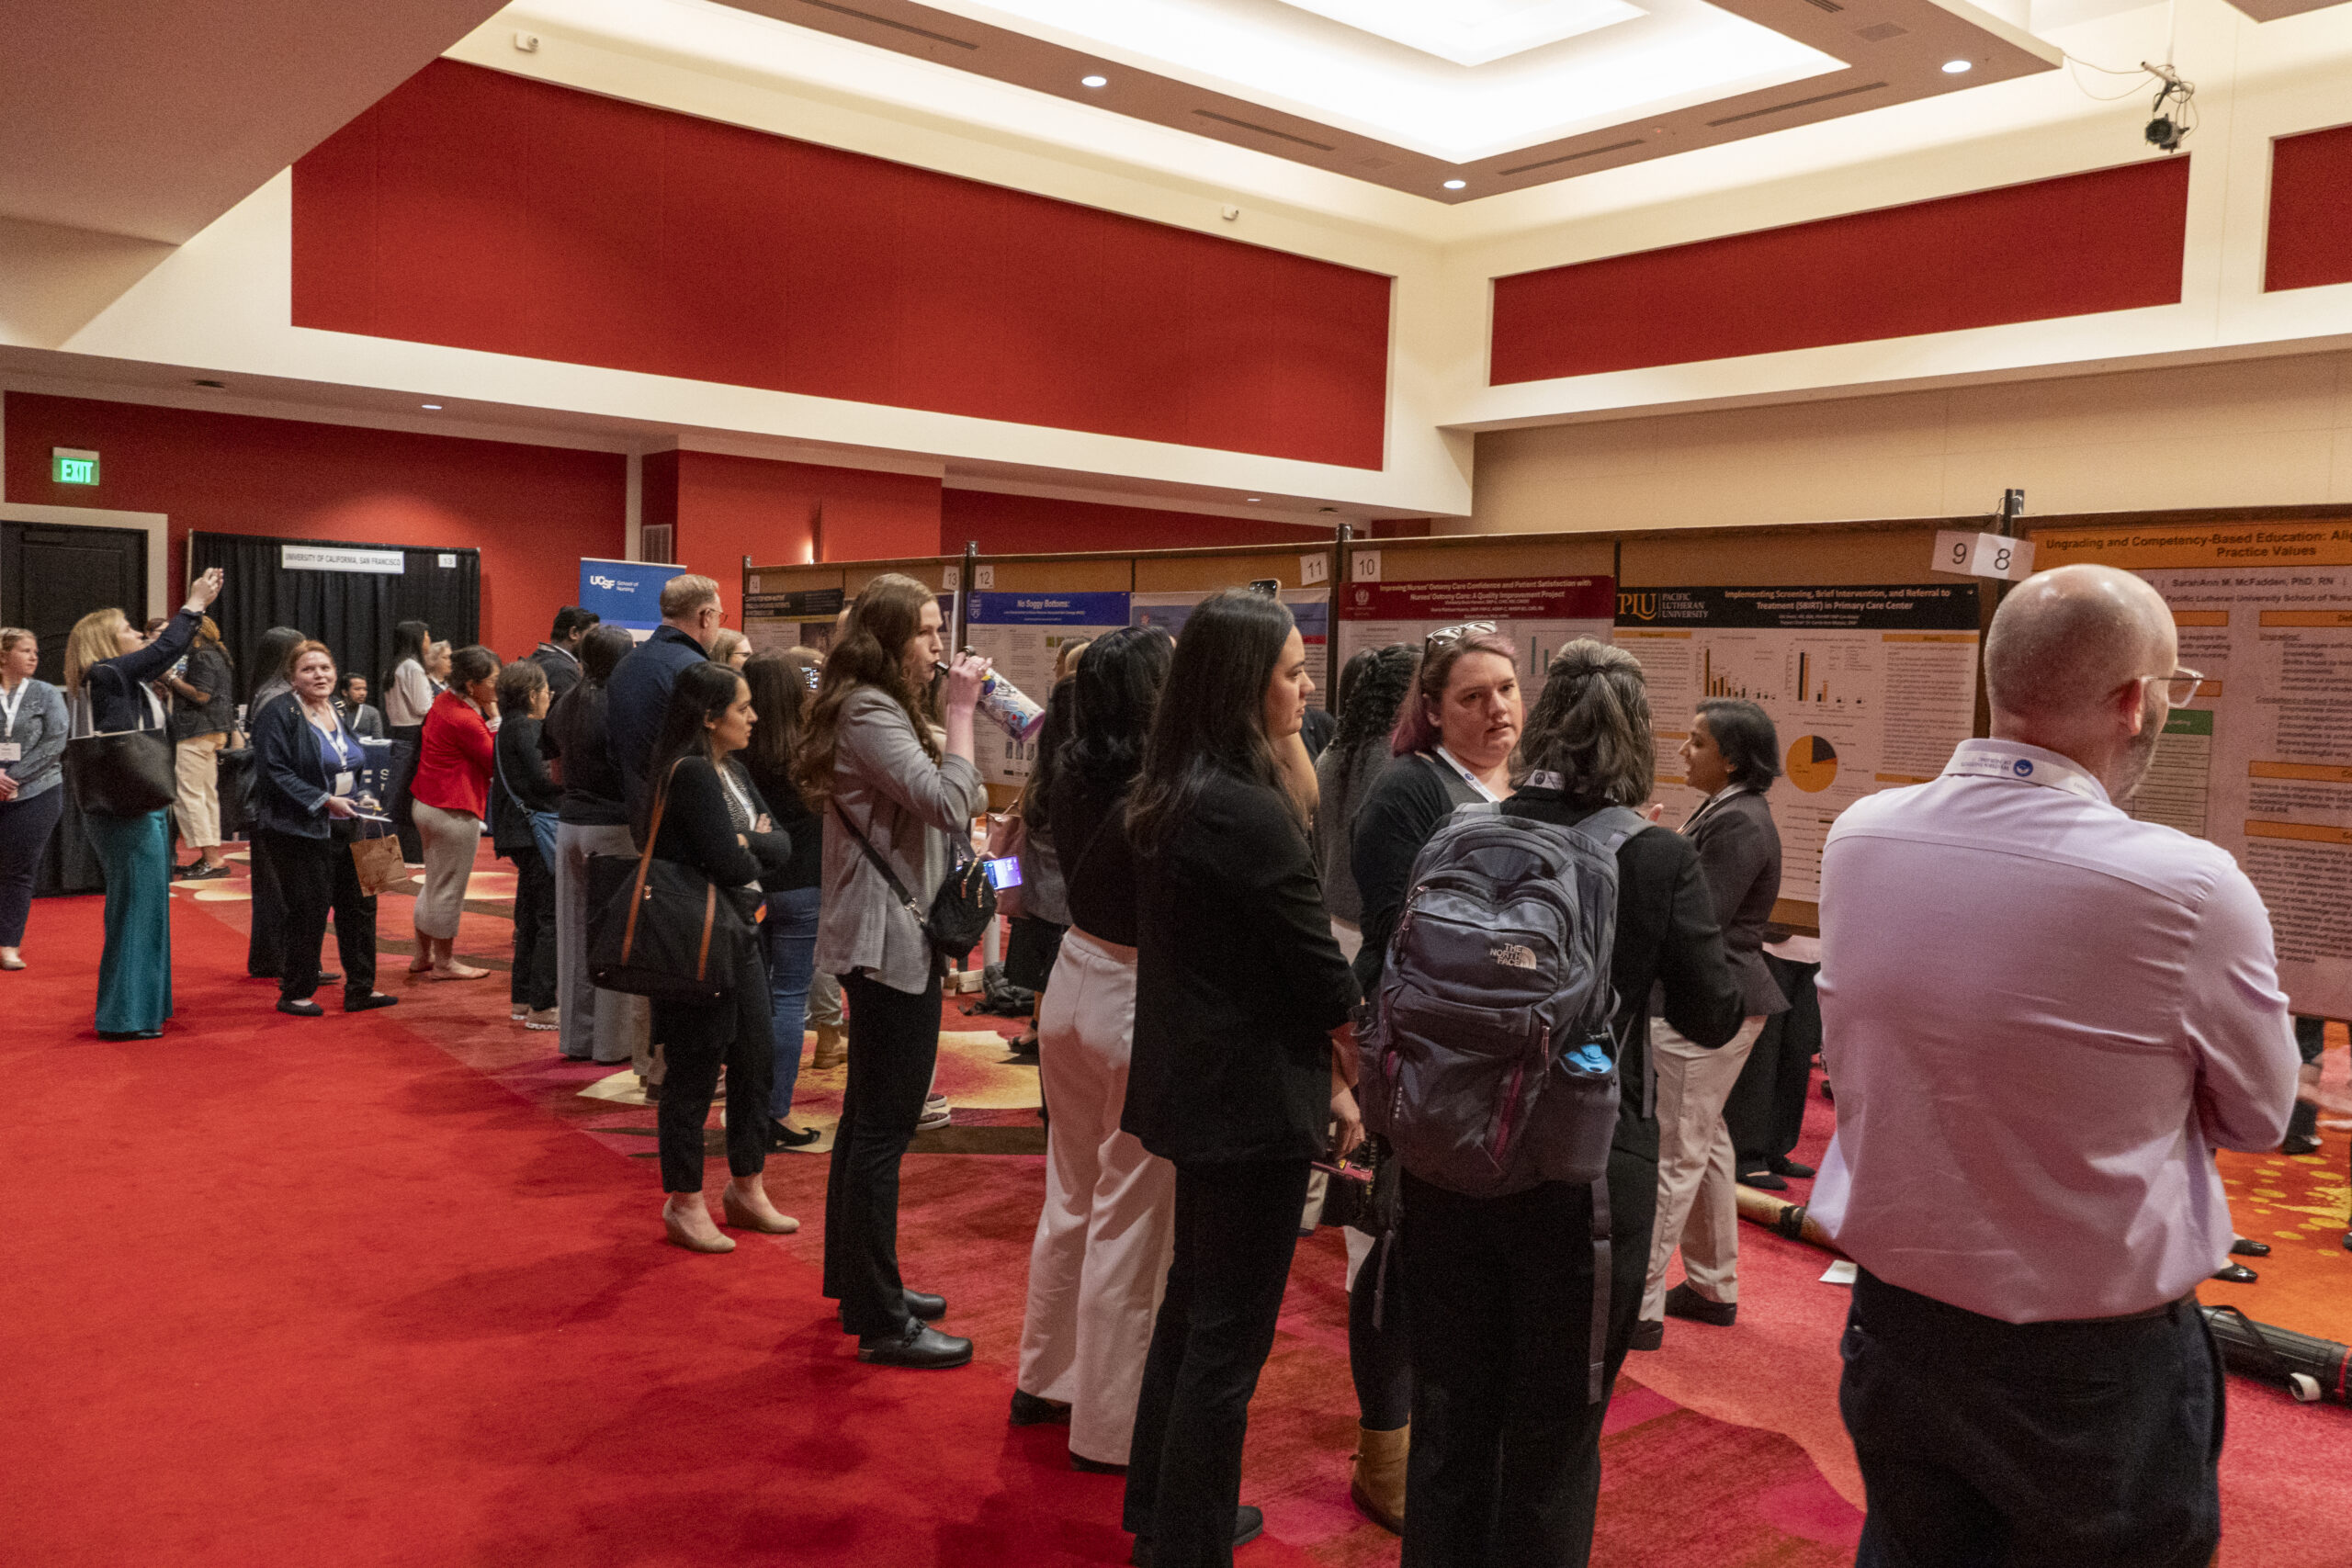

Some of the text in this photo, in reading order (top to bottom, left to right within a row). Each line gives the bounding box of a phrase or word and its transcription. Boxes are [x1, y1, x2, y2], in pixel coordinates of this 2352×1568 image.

[61, 458, 94, 484] EXIT
[2045, 538, 2104, 551] Ungrading
[2107, 536, 2130, 547] and
[2132, 533, 2253, 548] Competency-Based
[2256, 531, 2326, 543] Education:
[285, 552, 401, 566] UNIVERSITY OF CALIFORNIA, SAN FRANCISCO
[1951, 542, 1967, 565] 9
[1994, 547, 2011, 570] 8
[2216, 546, 2317, 558] Practice Values
[1307, 559, 1323, 579] 11
[1359, 558, 1375, 576] 10
[590, 575, 616, 590] UCSF
[948, 572, 957, 586] 13
[979, 570, 990, 585] 12
[2318, 577, 2335, 586] RN
[1662, 592, 1691, 601] PACIFIC
[1888, 589, 1905, 597] and
[1905, 588, 1940, 597] Referral
[1941, 589, 1951, 597] to
[1617, 593, 1657, 620] PLU
[1662, 602, 1706, 610] LUTHERAN
[1757, 602, 1794, 610] Treatment
[1824, 602, 1833, 610] in
[1833, 602, 1865, 611] Primary
[1865, 602, 1884, 610] Care
[1885, 601, 1914, 610] Center
[1662, 610, 1709, 618] UNIVERSITY
[1489, 948, 1521, 960] NORTH
[1504, 942, 1522, 953] THE
[1497, 957, 1521, 967] FACE
